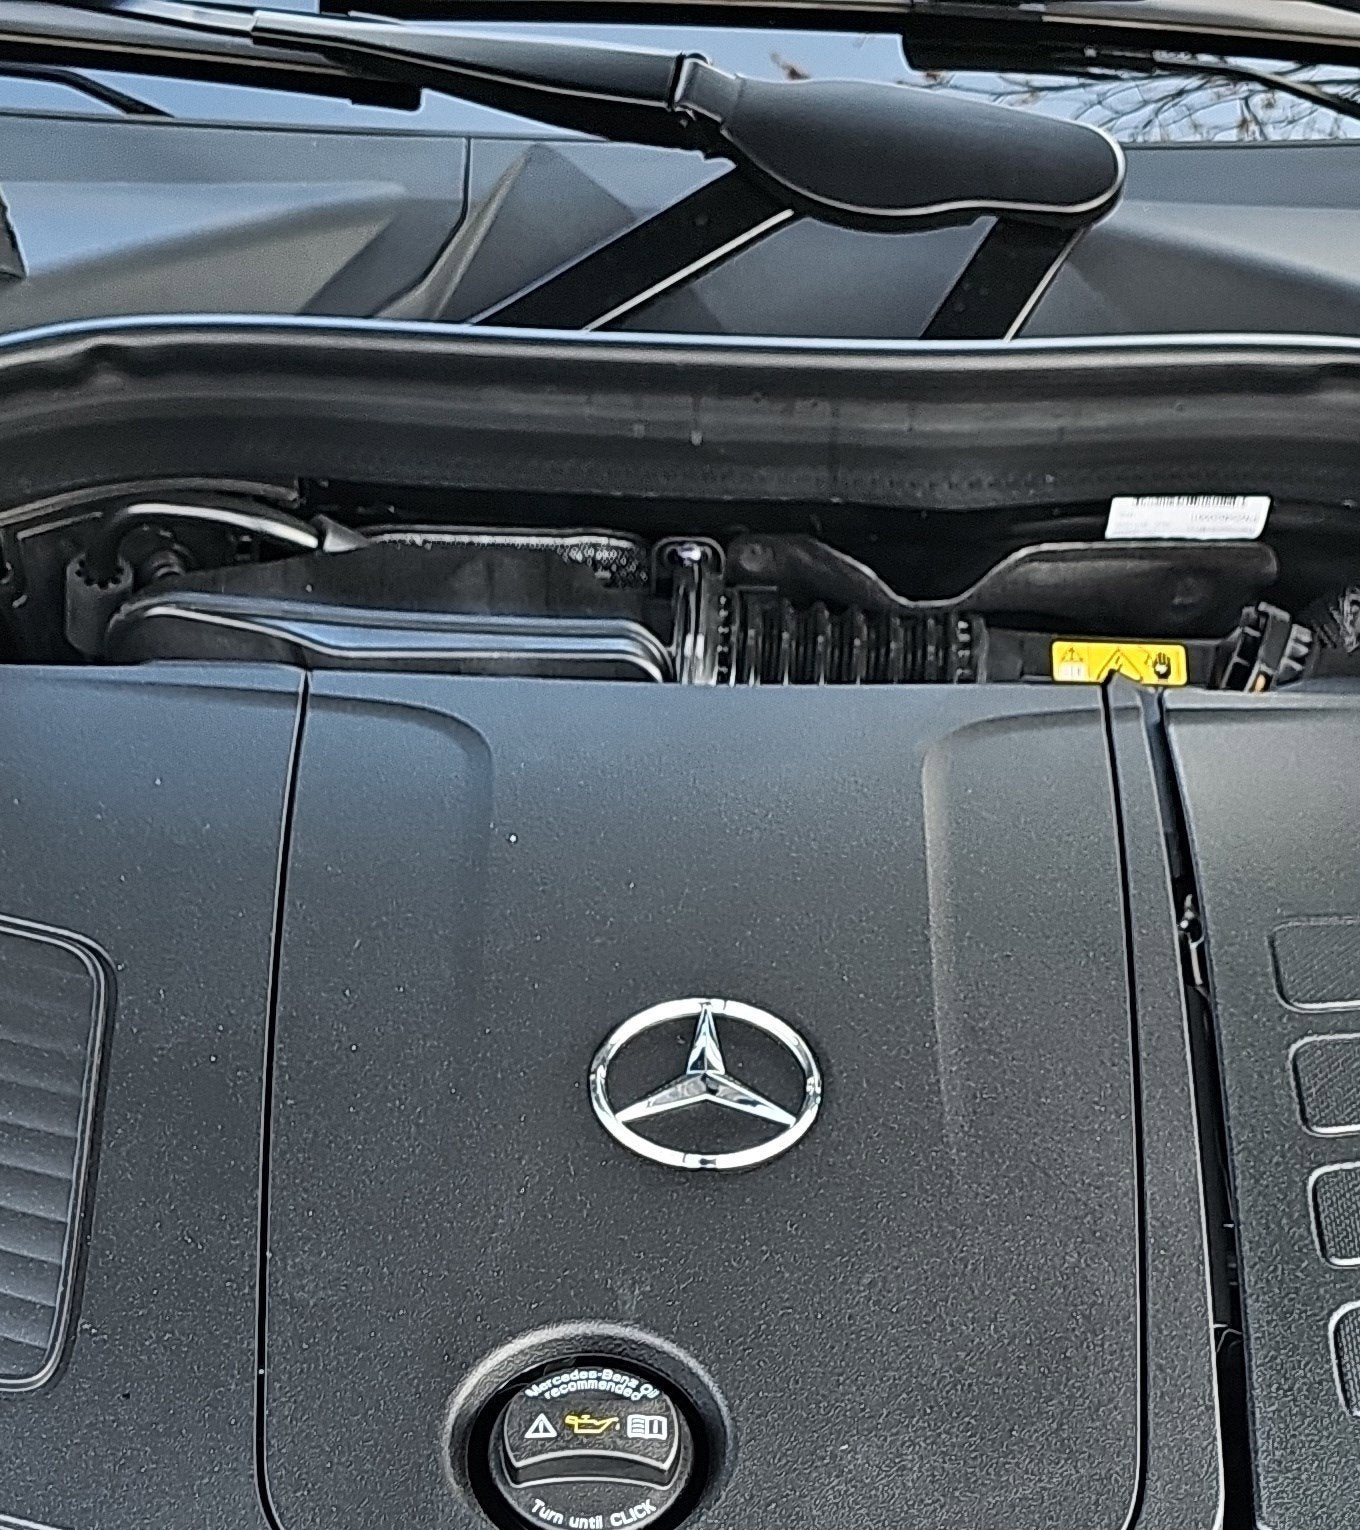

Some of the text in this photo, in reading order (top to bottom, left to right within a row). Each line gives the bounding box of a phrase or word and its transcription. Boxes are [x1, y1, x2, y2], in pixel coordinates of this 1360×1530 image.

[524, 1368, 639, 1397] Mercedes-Benz
[544, 1380, 641, 1401] recommended
[531, 1498, 657, 1530] Turn until CLICK
